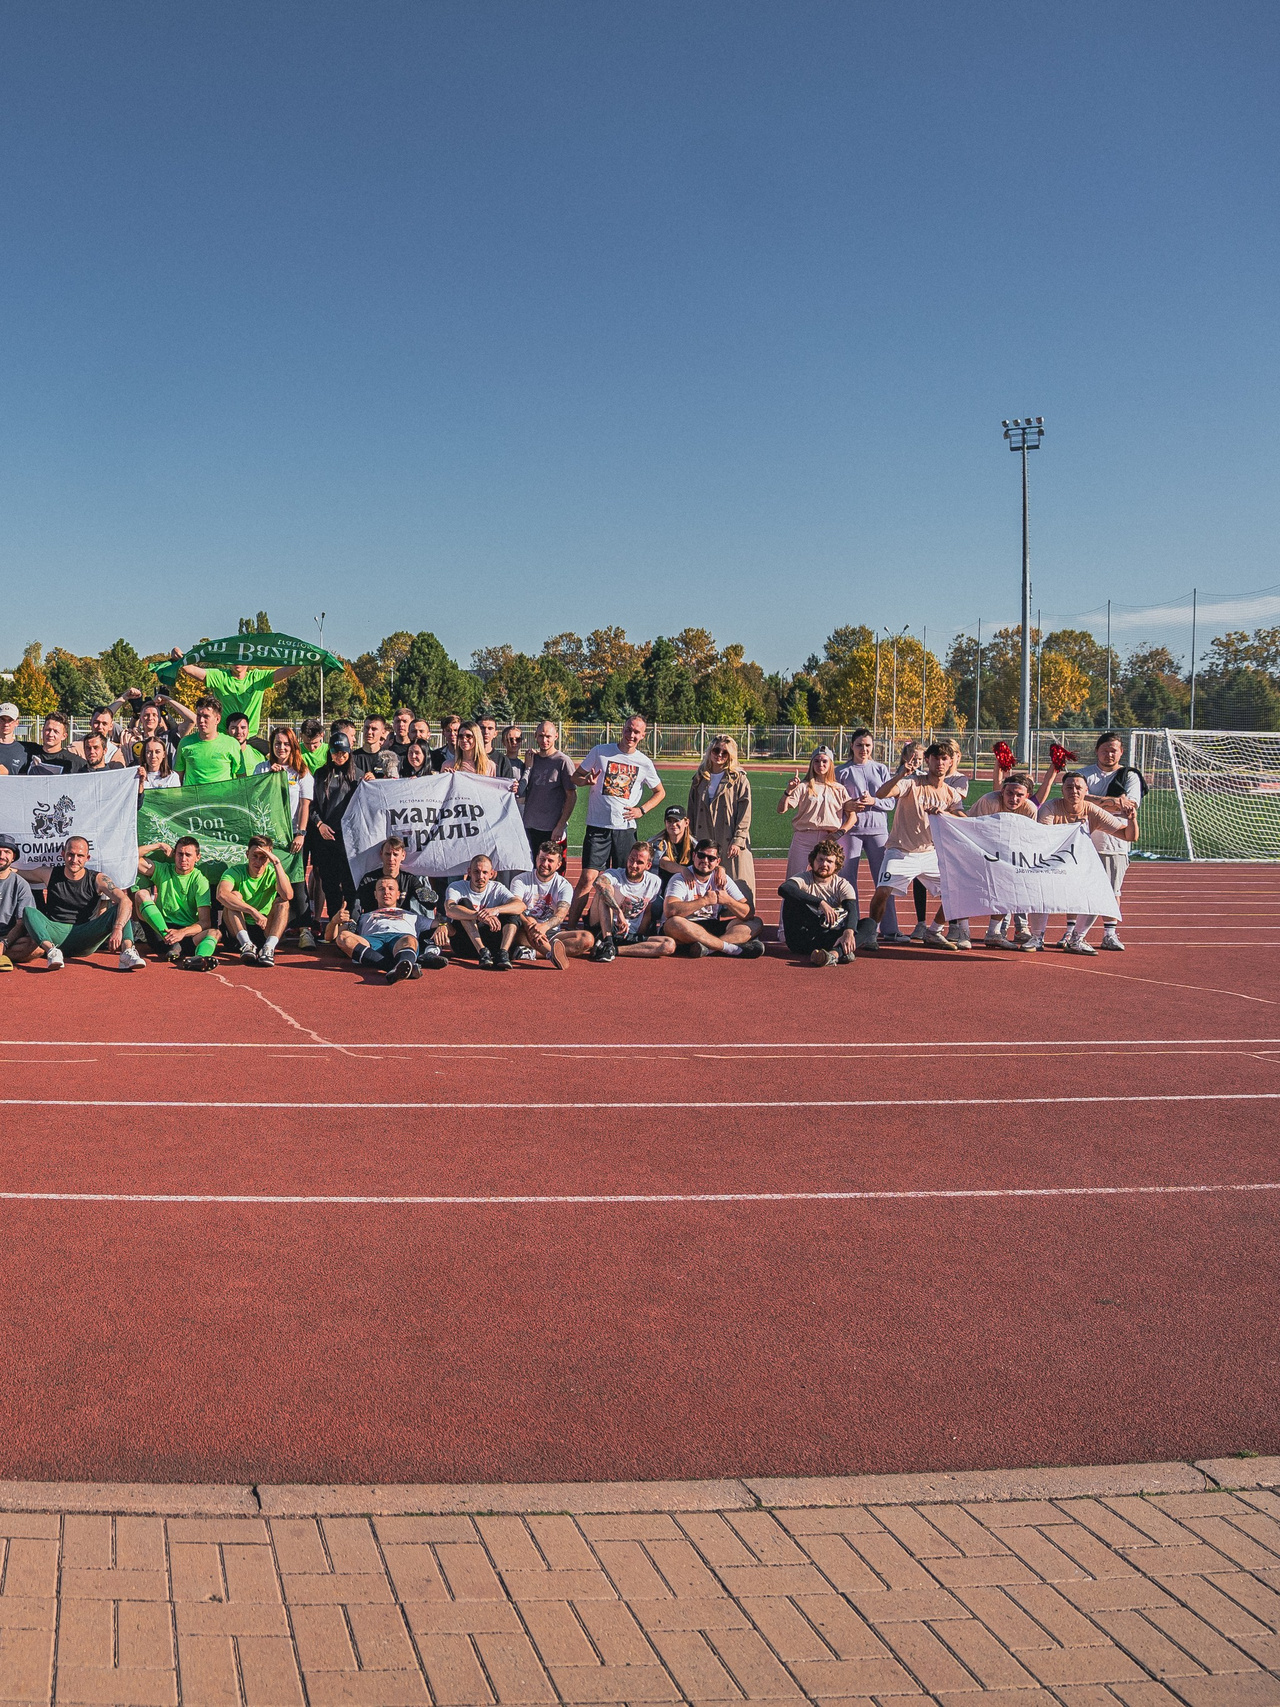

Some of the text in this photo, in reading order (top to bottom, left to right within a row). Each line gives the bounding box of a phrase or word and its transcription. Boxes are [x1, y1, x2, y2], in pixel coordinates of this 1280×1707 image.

[188, 816, 226, 833] Don
[27, 855, 54, 863] ASIAN
[879, 871, 892, 882] 19
